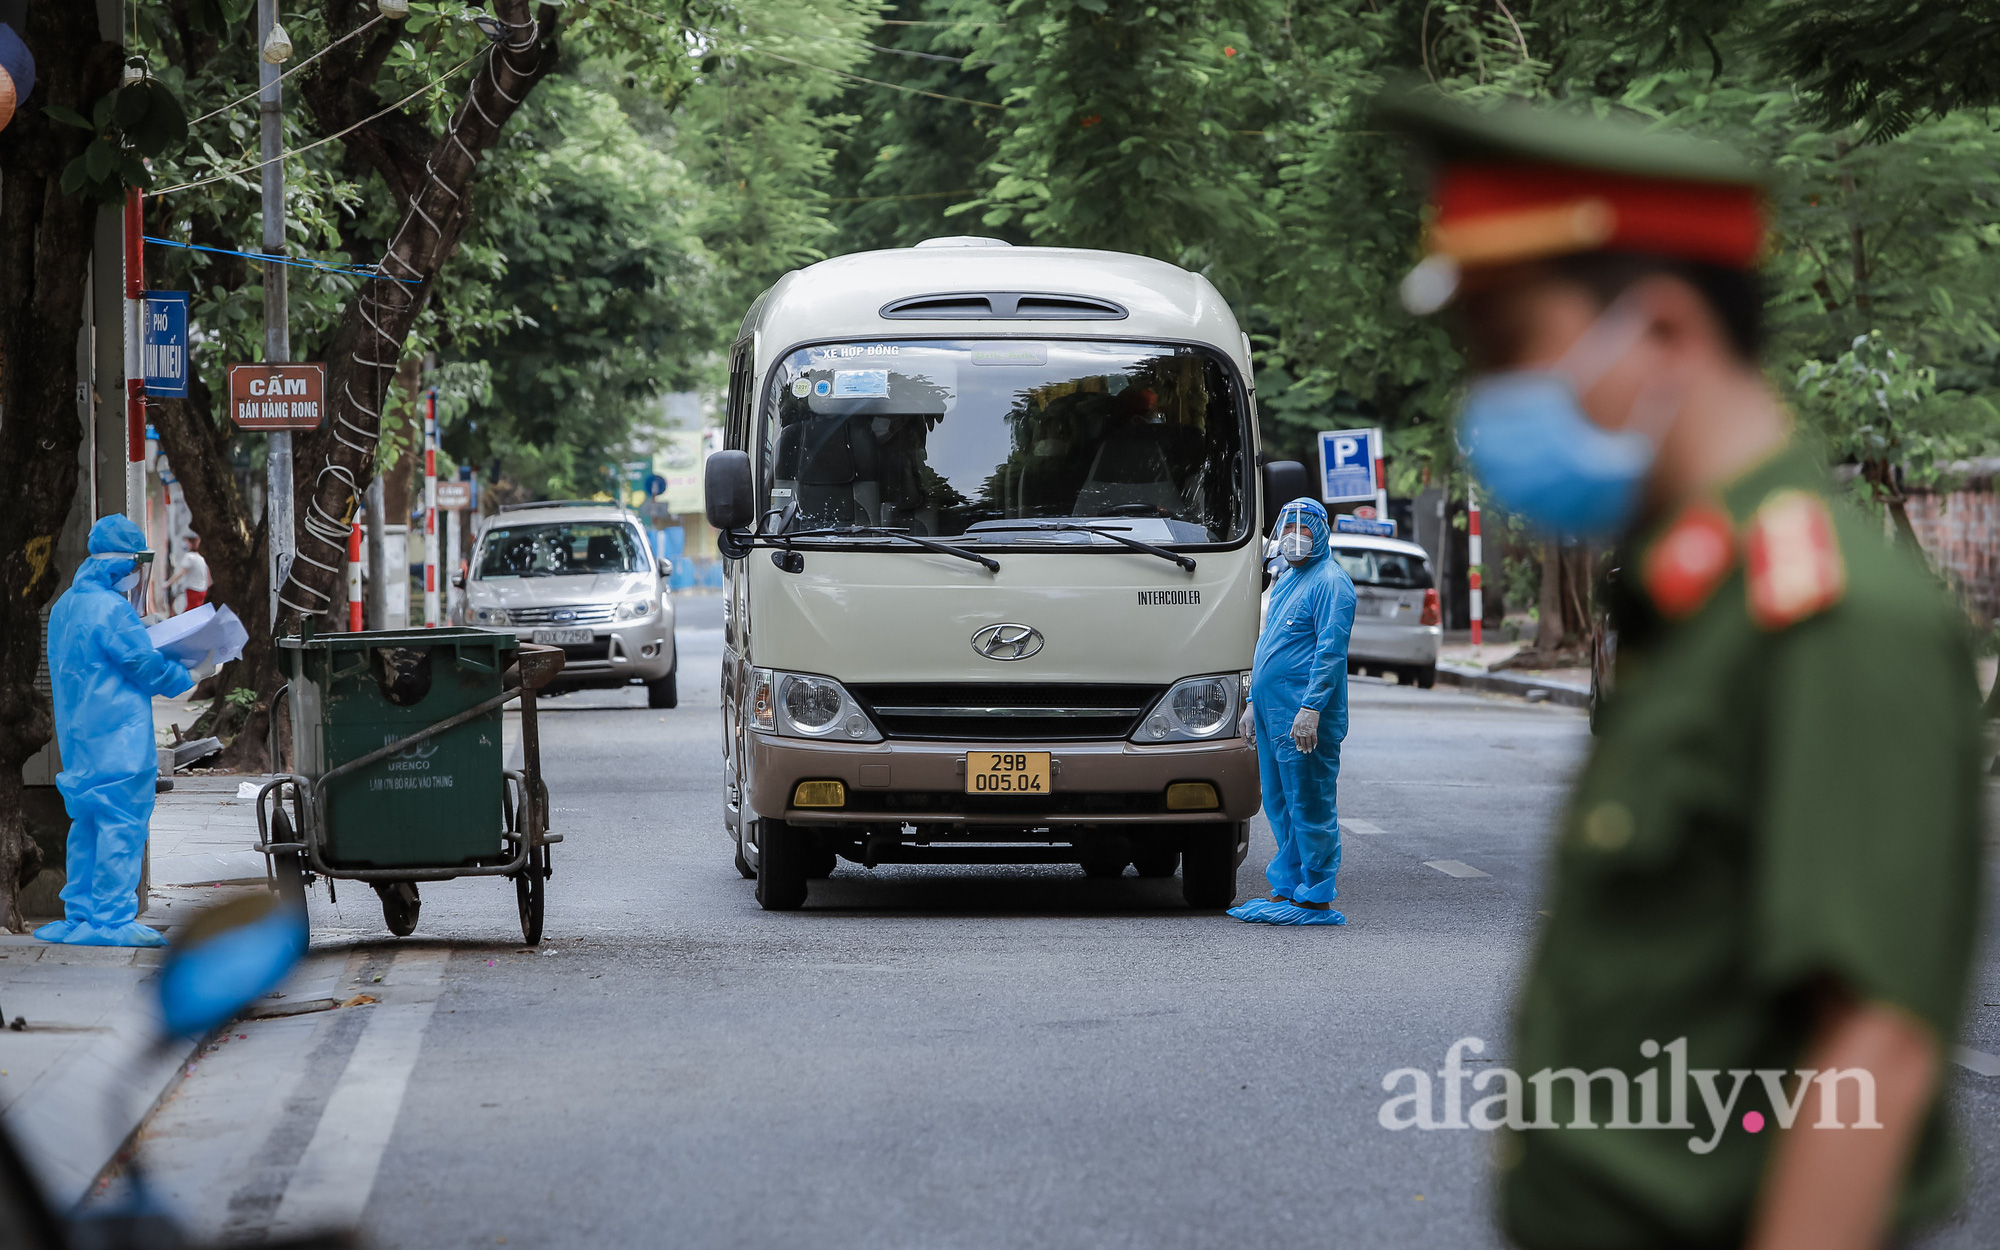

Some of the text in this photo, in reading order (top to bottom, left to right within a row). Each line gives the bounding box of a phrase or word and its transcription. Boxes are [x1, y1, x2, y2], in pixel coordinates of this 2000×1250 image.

[153, 305, 169, 332] PHỐ
[159, 334, 182, 379] MIẾU
[823, 343, 899, 359] XE HỢP ĐỒNG
[249, 374, 307, 396] CẤM
[239, 398, 318, 419] BÁN HÀNG RONG
[1334, 437, 1359, 468] P
[1137, 590, 1201, 606] INTERCOOLER
[388, 760, 430, 771] URENCO
[991, 754, 1027, 771] 29B
[976, 774, 1041, 791] 005.04
